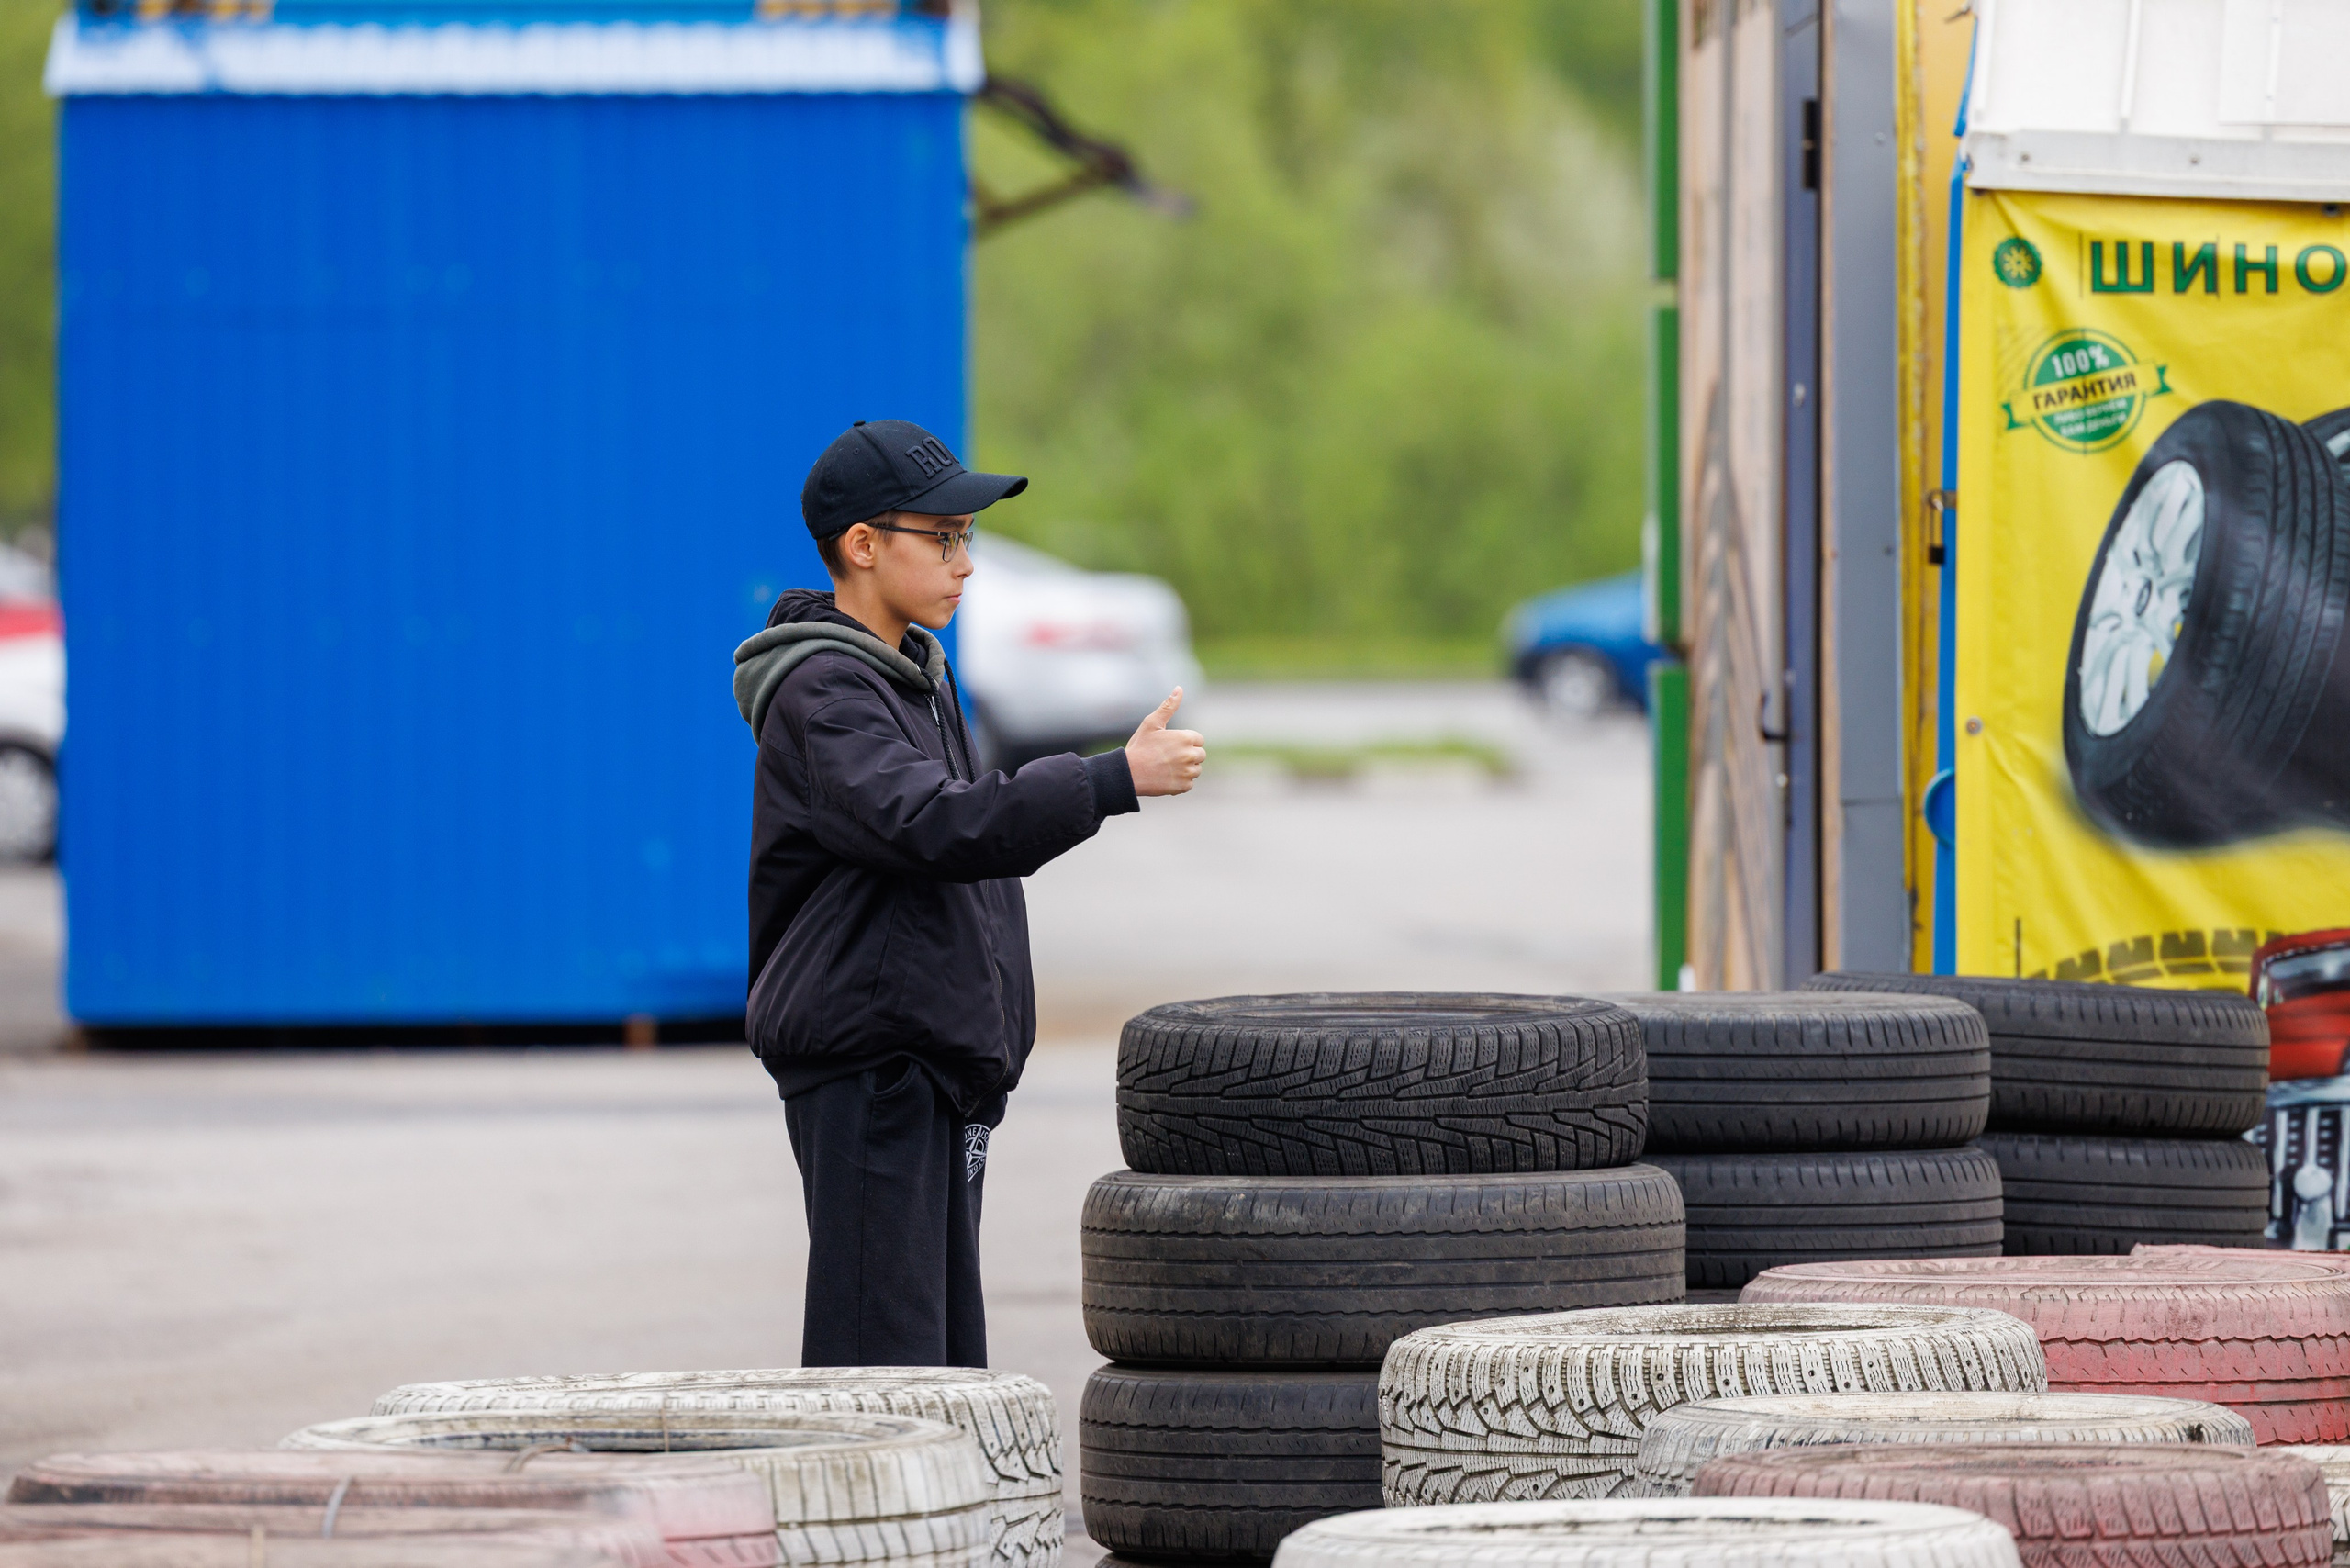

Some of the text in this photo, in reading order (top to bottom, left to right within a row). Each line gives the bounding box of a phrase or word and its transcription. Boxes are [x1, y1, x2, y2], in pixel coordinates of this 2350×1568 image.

[2091, 241, 2347, 294] ШИНО
[2051, 344, 2109, 378] 100%
[2033, 373, 2136, 409] ГАРАНТИЯ
[905, 436, 955, 479] RO
[1863, 1258, 2060, 1274] DUNLOP
